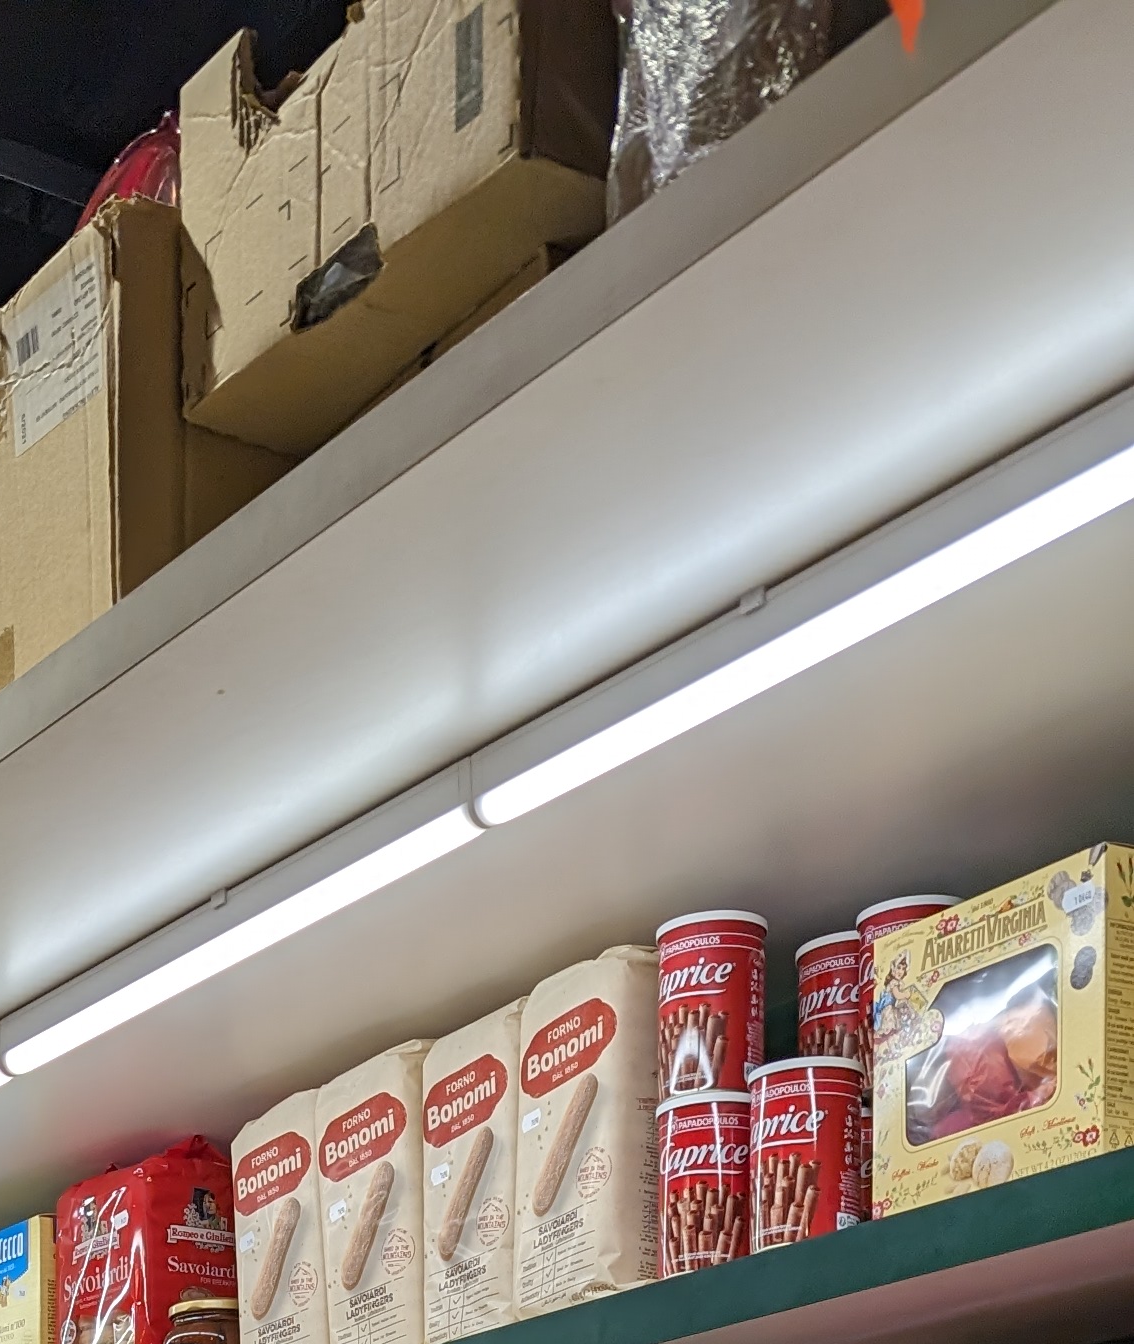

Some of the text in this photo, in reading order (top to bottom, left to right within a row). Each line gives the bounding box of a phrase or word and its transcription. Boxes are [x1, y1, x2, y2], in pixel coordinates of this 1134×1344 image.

[983, 901, 1046, 945] VIRGINIA
[547, 1015, 581, 1044] FORNO
[527, 1015, 604, 1081] Bonomi
[427, 1071, 496, 1132] Bonomi
[445, 1070, 476, 1097] FORNO
[325, 1108, 395, 1167] Bonomi
[342, 1108, 371, 1133] FORNO
[237, 1147, 302, 1201] Bonomi
[251, 1146, 279, 1169] FORNO
[167, 1255, 236, 1278] Savoiard
